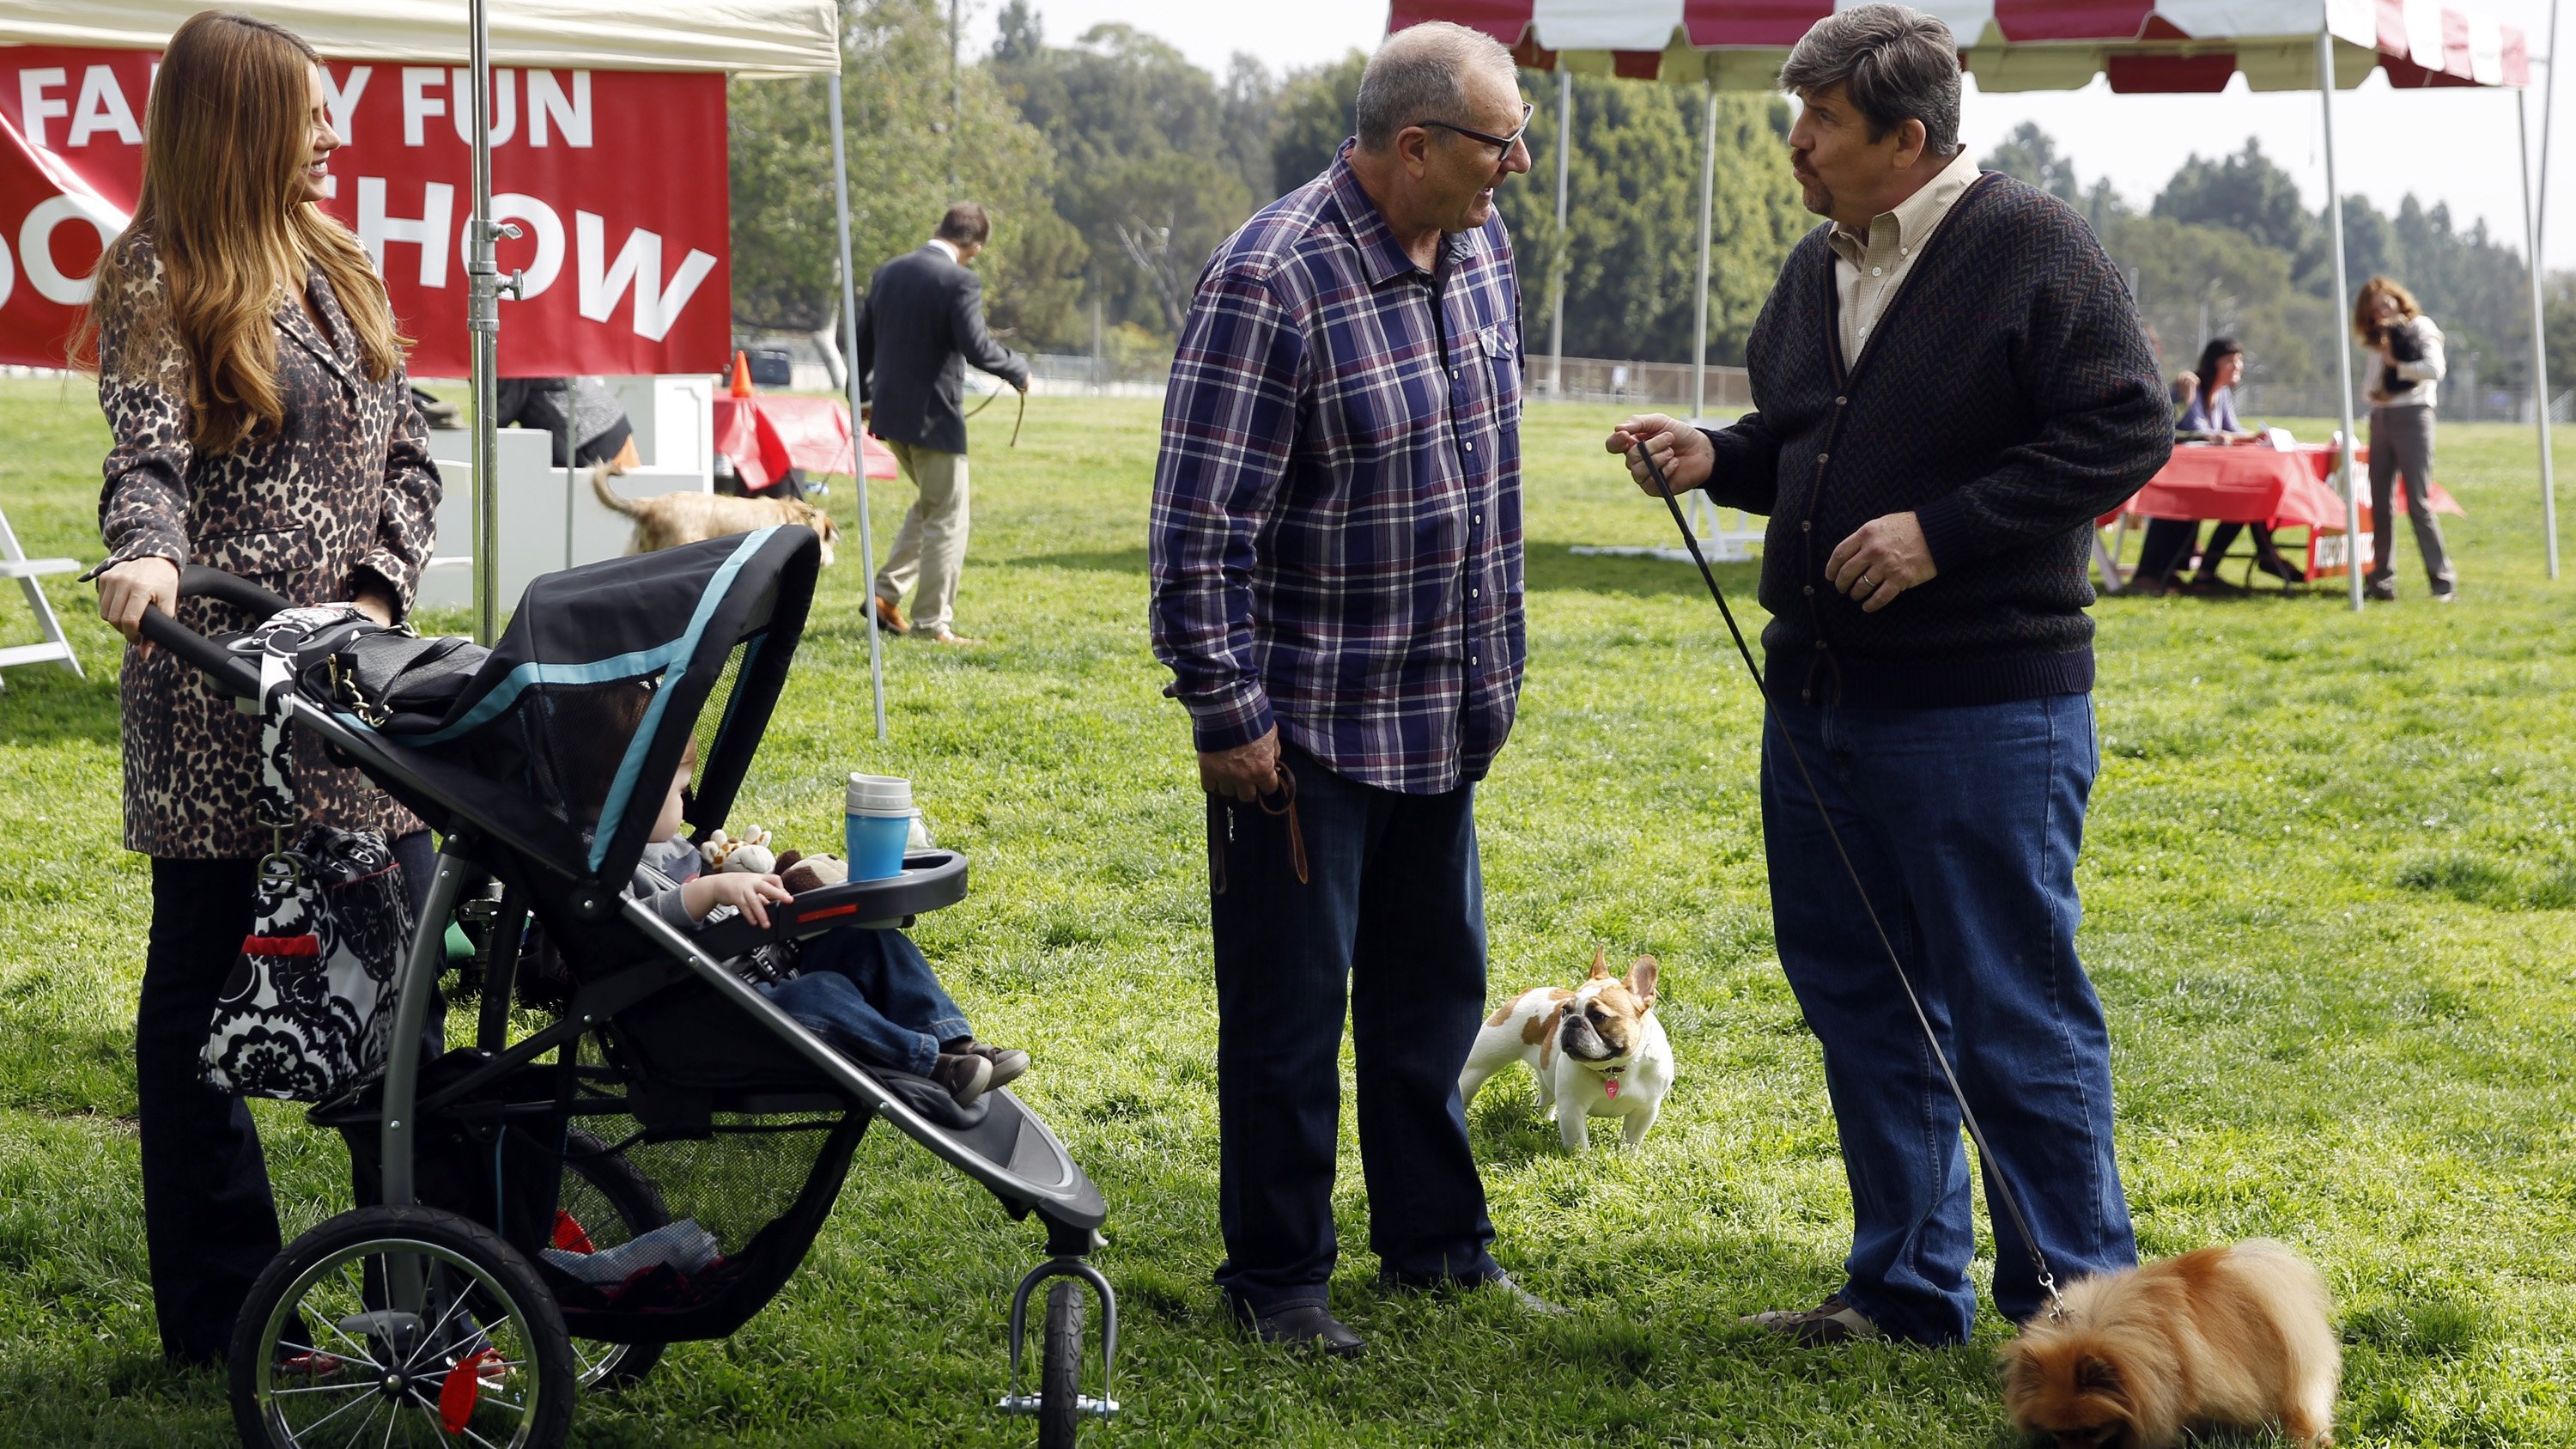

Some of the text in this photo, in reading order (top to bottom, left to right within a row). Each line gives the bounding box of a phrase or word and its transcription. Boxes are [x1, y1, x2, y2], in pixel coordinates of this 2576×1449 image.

[19, 64, 593, 148] FAY FUN
[325, 174, 718, 343] HOW
